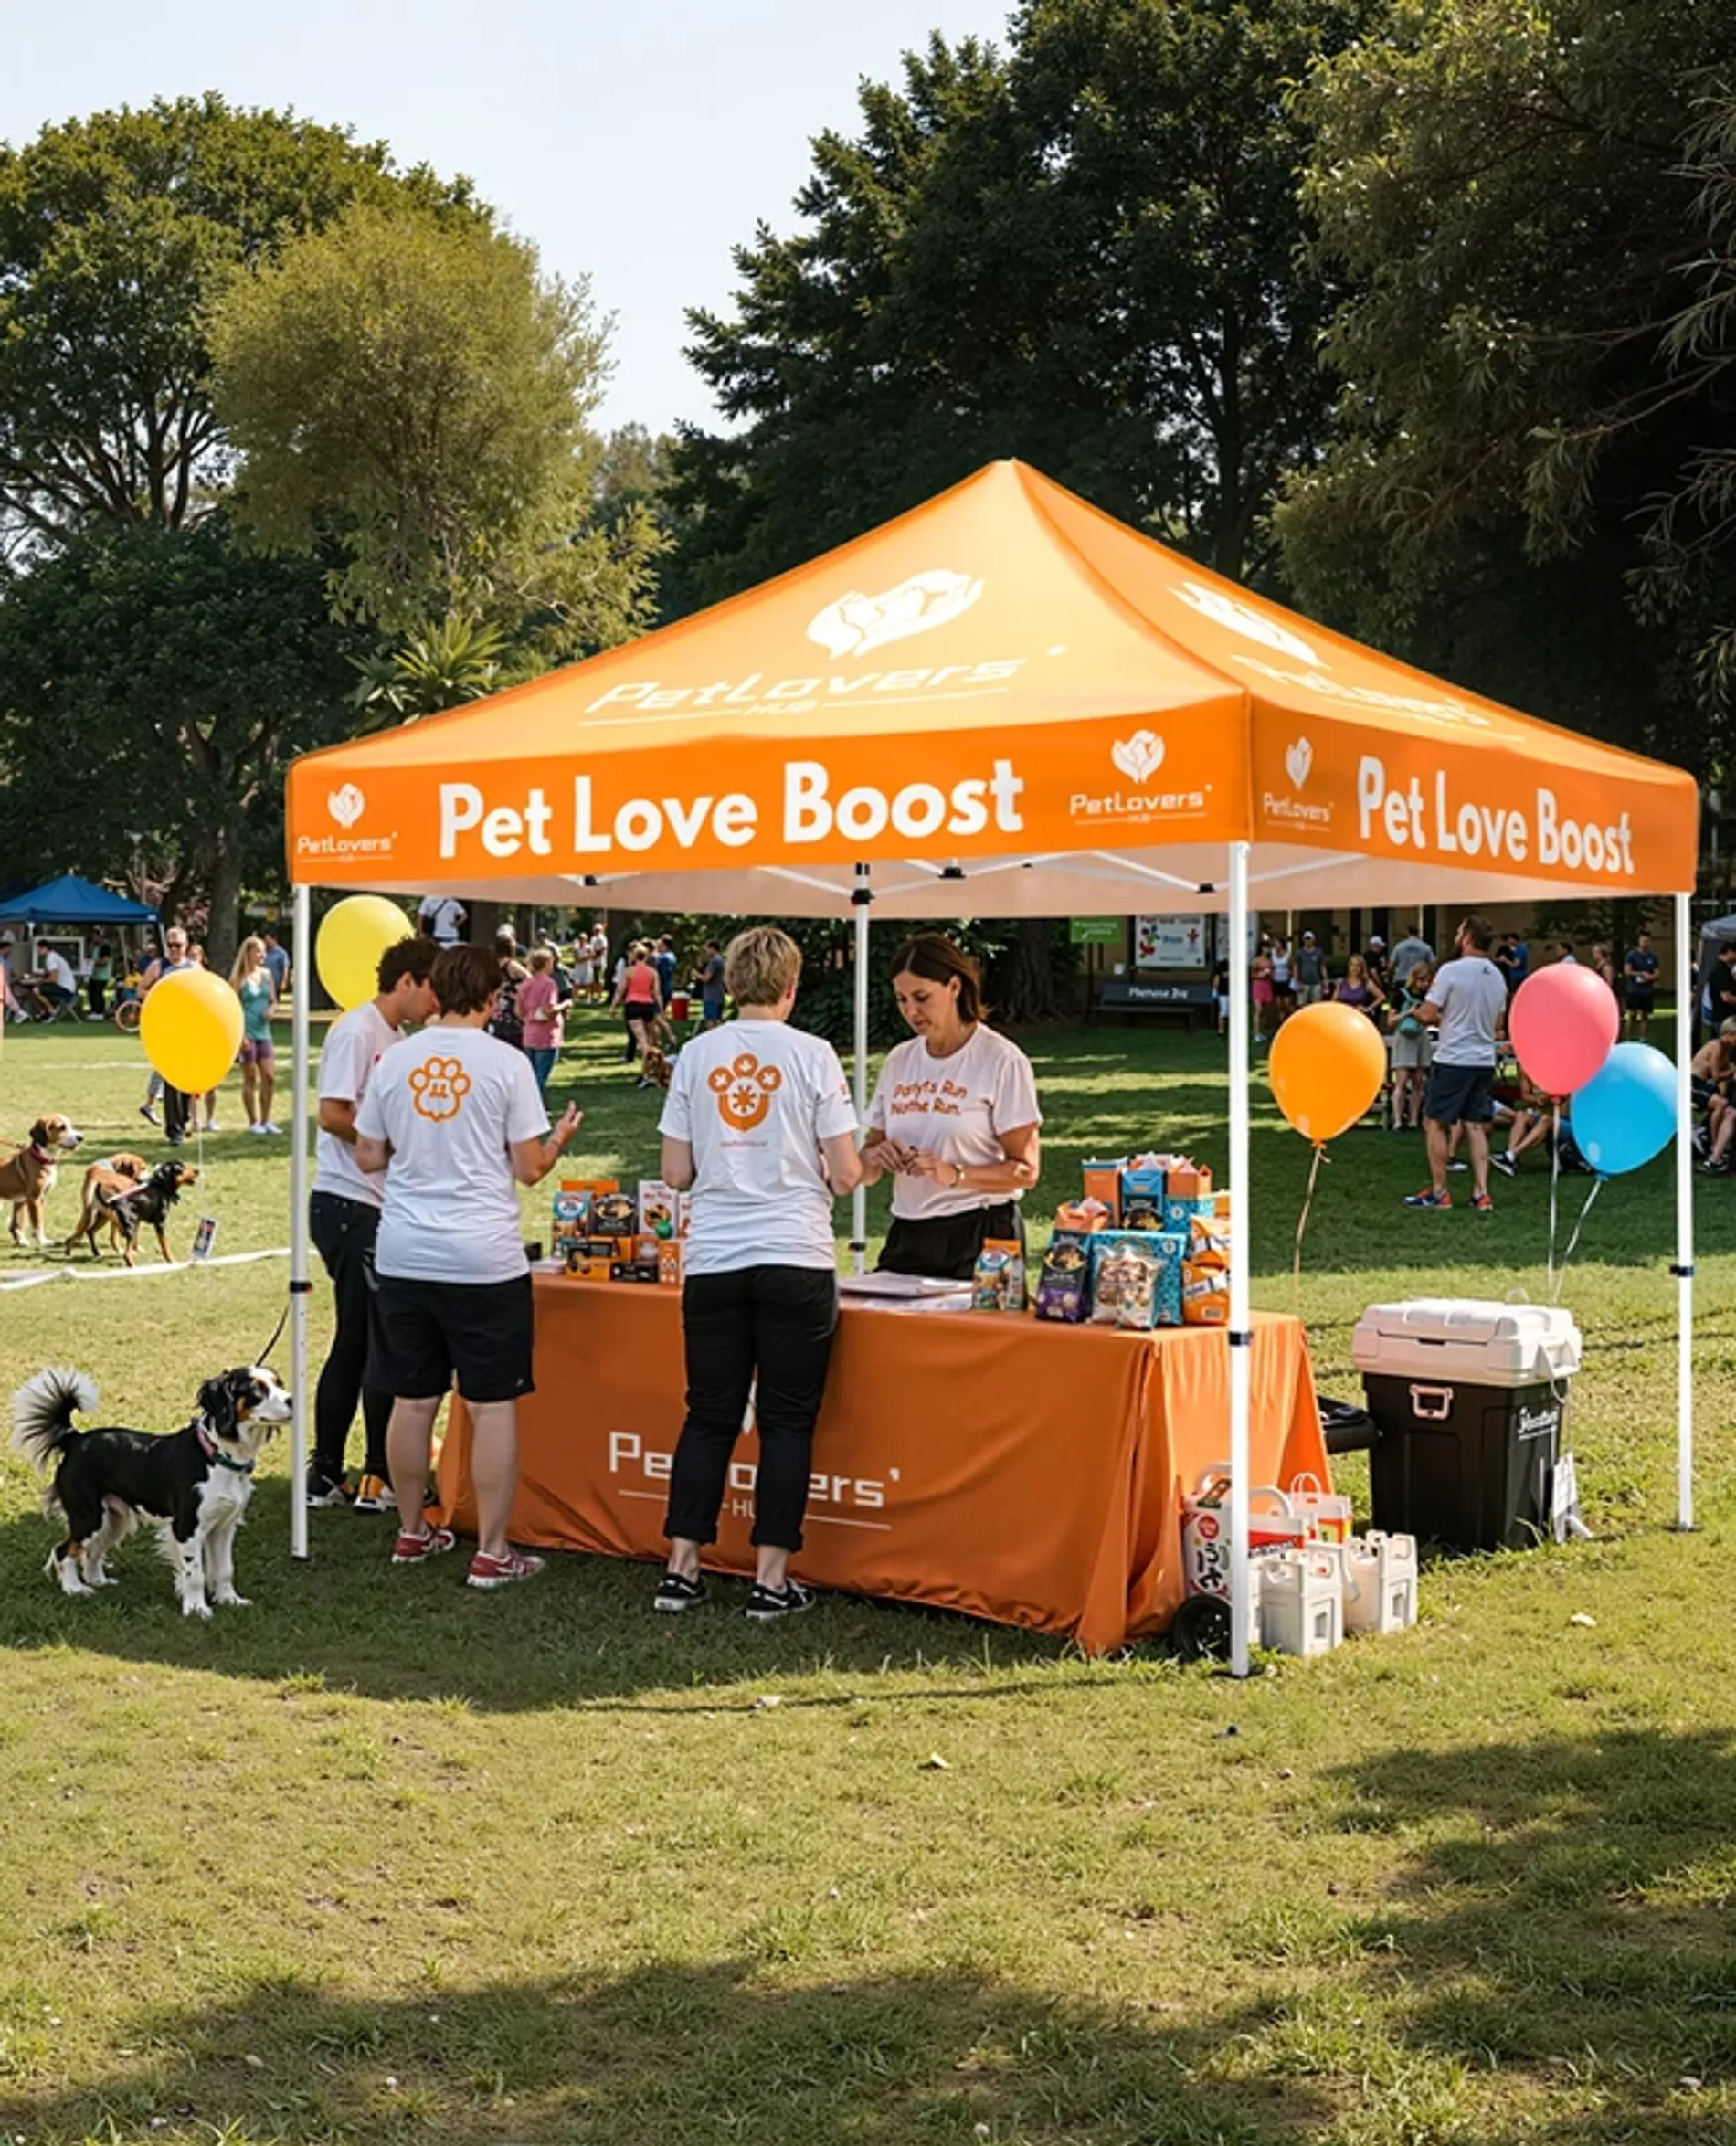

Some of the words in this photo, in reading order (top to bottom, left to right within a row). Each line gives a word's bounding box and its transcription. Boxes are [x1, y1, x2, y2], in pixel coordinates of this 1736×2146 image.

[585, 659, 1027, 713] PetLovers
[439, 783, 553, 859] Pet
[574, 776, 757, 852] Love
[783, 759, 1024, 843] Boost
[1358, 756, 1425, 848] Pet
[1435, 770, 1527, 861] Love
[1537, 788, 1635, 874] Boost
